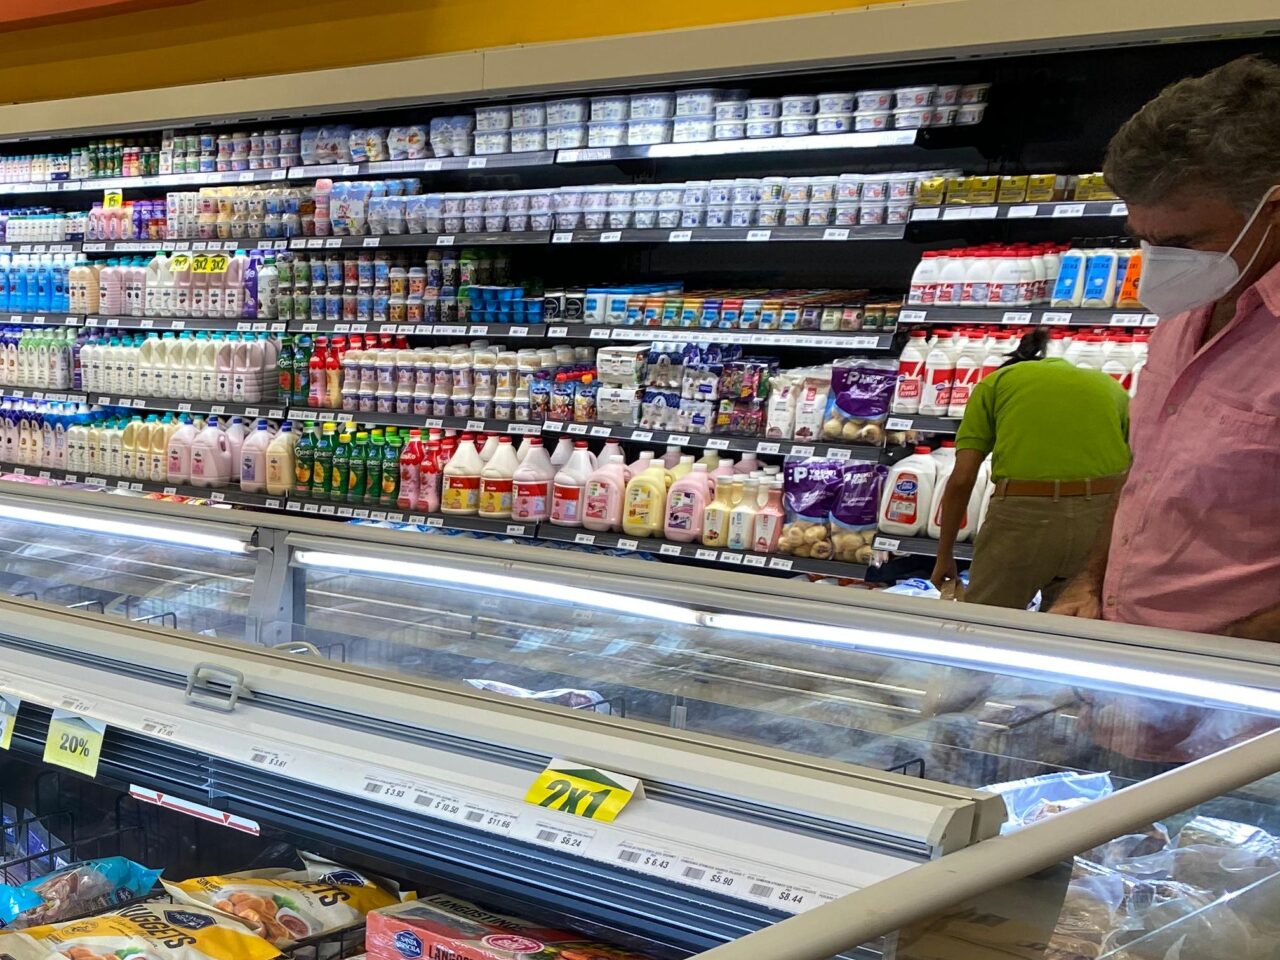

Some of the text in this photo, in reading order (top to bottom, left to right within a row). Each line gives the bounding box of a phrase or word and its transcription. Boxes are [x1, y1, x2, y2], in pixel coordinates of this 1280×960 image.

[59, 732, 91, 758] 20%
[709, 873, 734, 887] $5.90
[778, 891, 804, 905] $8.44
[121, 904, 197, 949] NUGGETS
